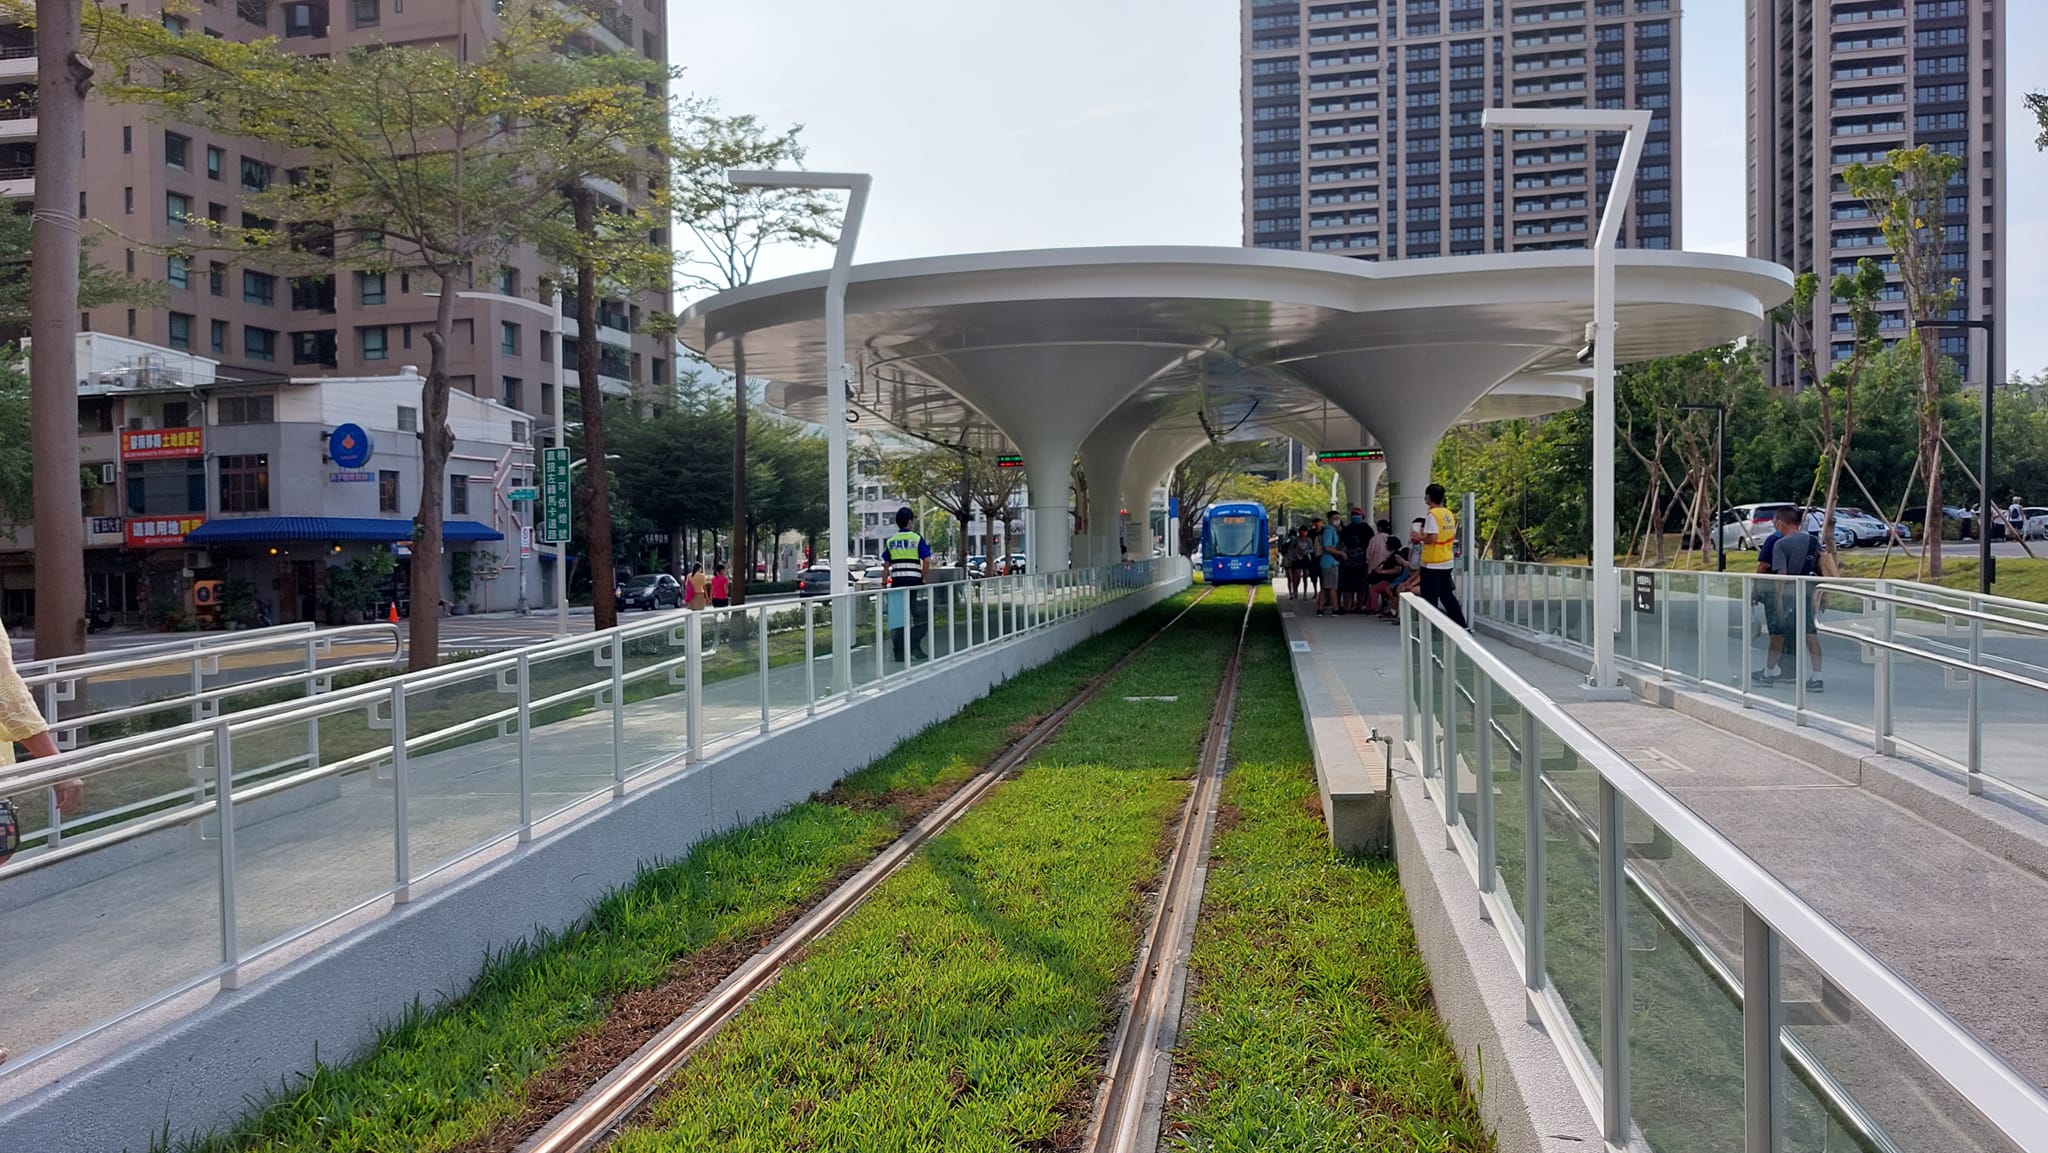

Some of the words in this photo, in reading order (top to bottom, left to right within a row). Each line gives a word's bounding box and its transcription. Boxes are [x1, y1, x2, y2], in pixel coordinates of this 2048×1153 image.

[547, 451, 557, 539] 直接左轉馬卡道路
[557, 450, 567, 539] 機車可依燈號
